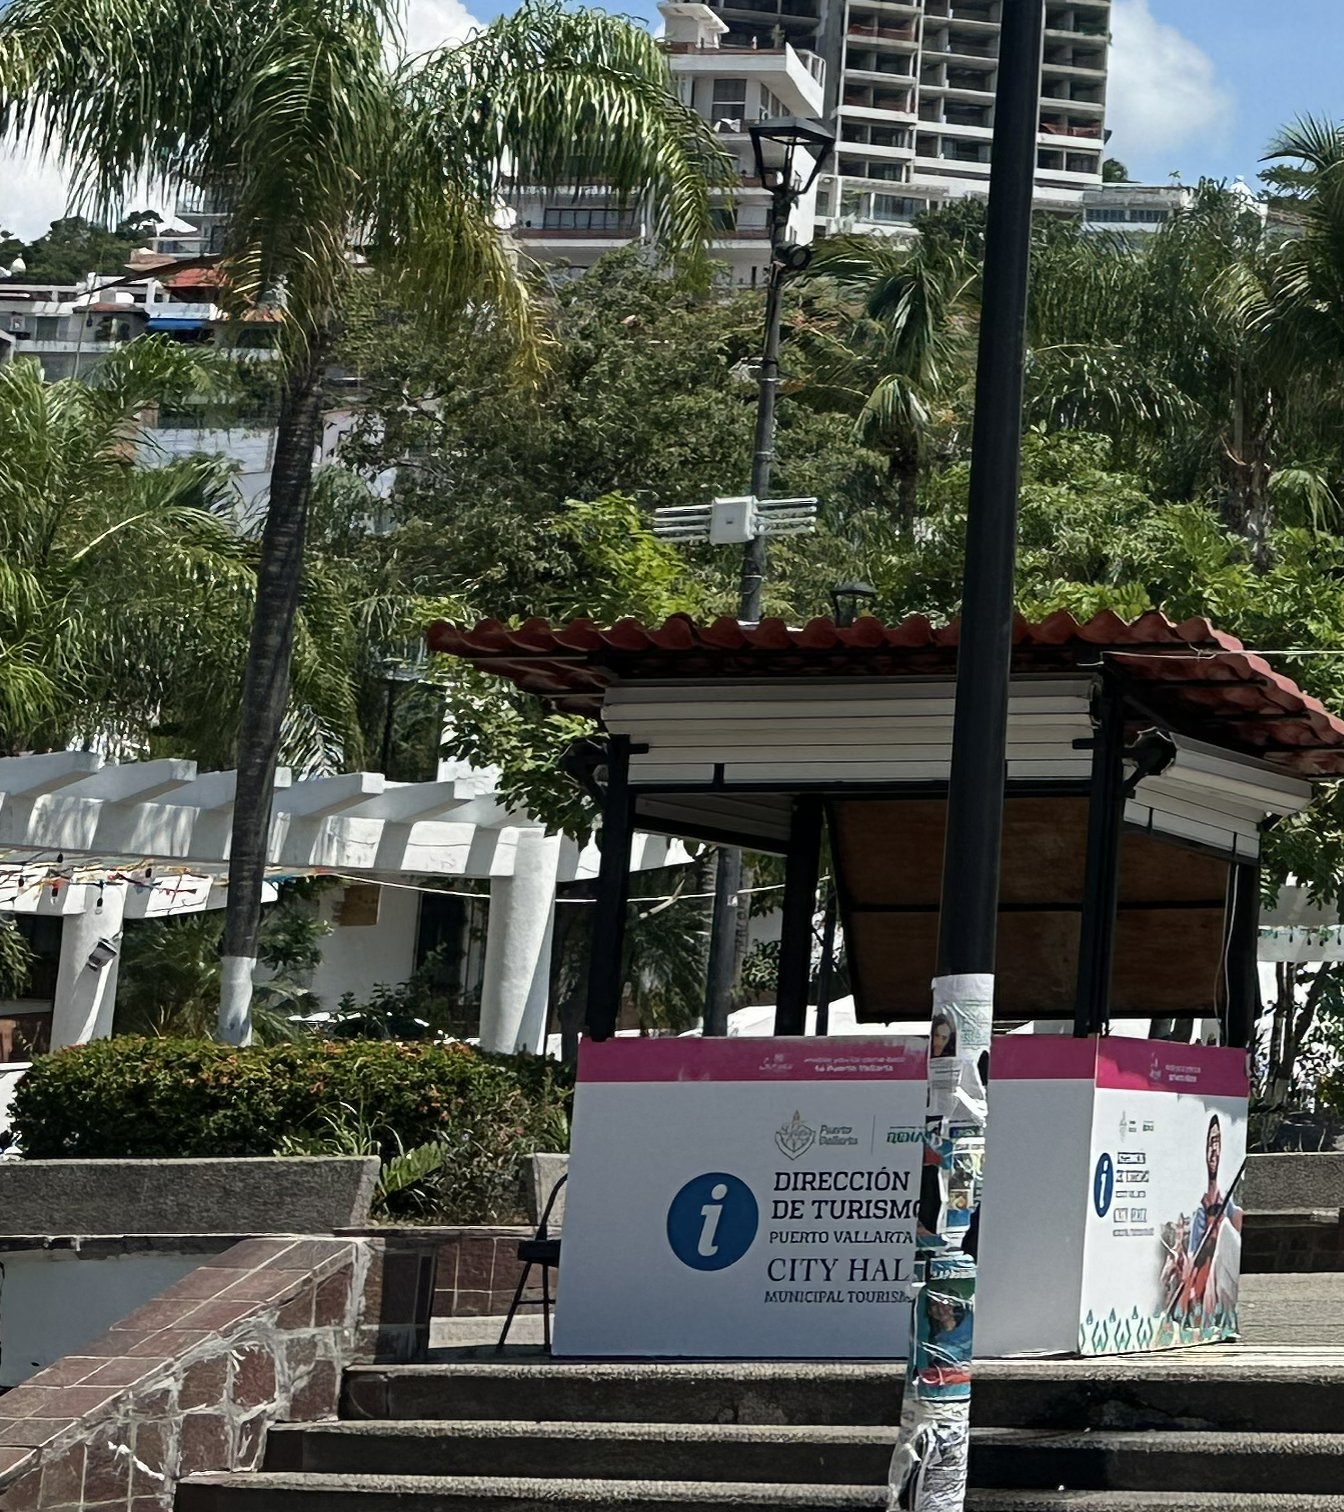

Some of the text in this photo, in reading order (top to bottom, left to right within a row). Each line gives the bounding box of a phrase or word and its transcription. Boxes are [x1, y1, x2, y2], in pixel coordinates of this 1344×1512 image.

[773, 1167, 911, 1192] DIRECCIÓN
[771, 1199, 805, 1220] DE
[769, 1230, 914, 1244] PUERTO VALLARTA
[767, 1257, 839, 1282] CITY
[847, 1257, 911, 1282] HAL
[764, 1290, 845, 1304] MUNICIPAL
